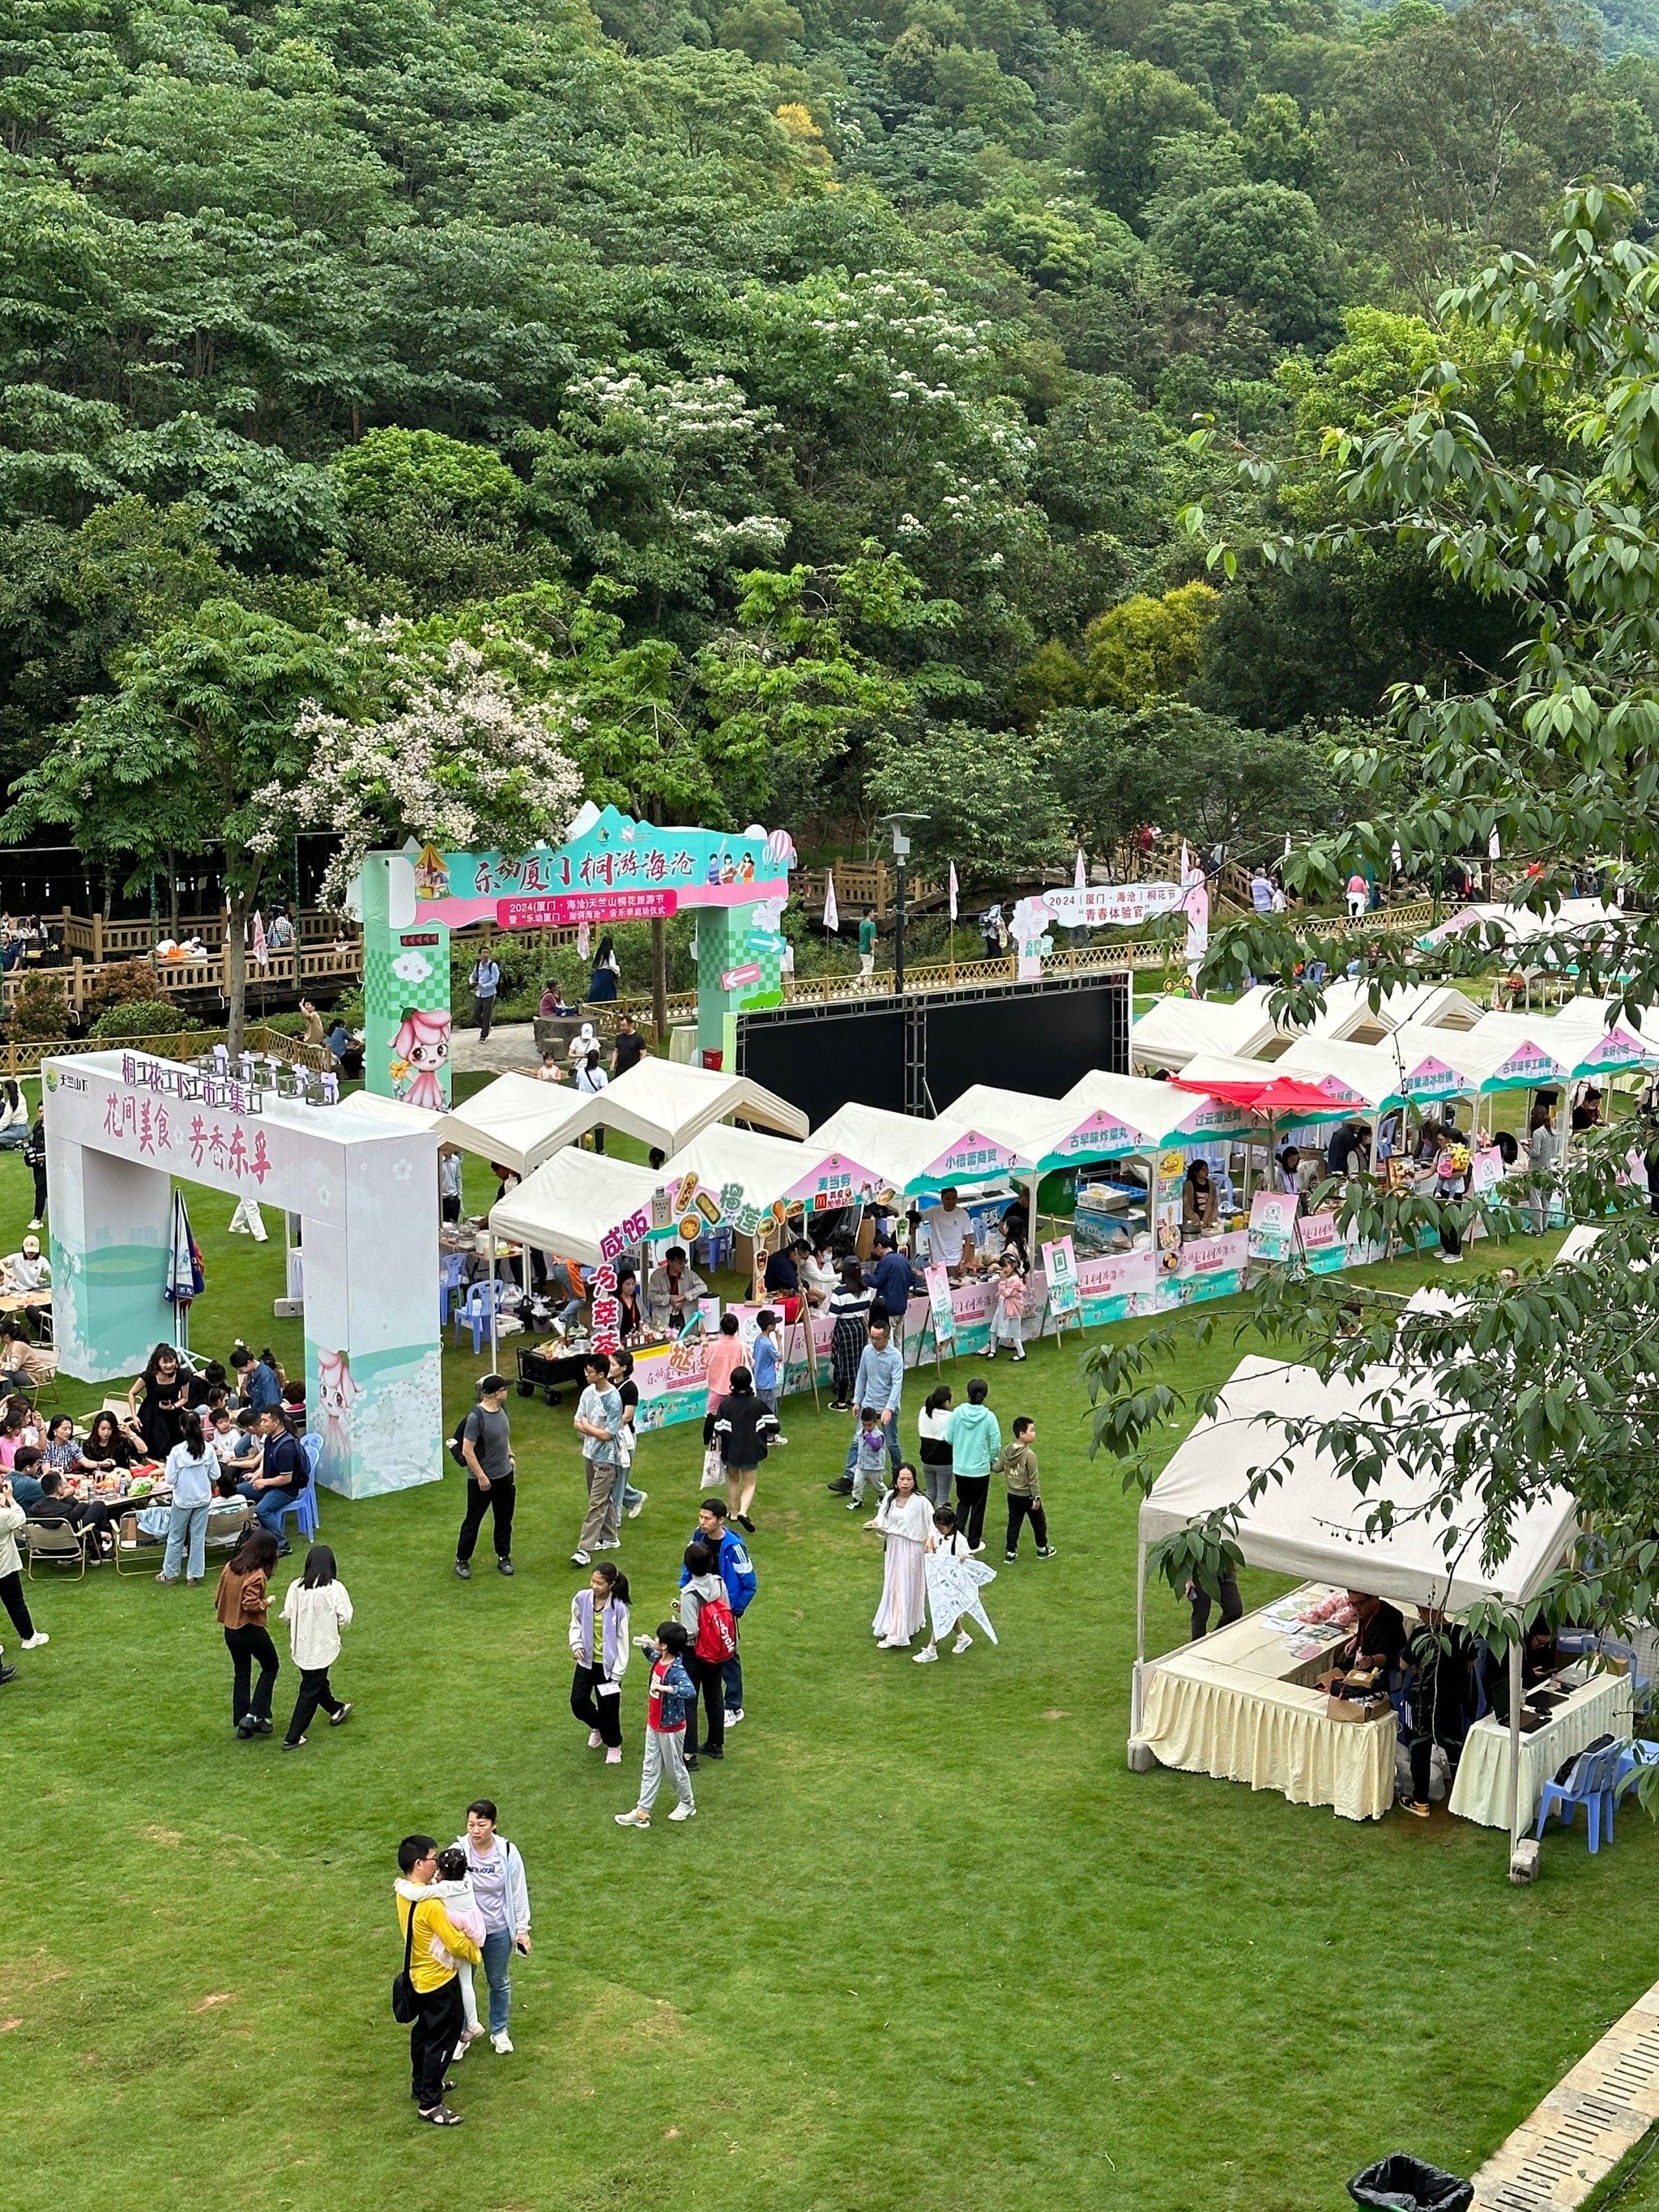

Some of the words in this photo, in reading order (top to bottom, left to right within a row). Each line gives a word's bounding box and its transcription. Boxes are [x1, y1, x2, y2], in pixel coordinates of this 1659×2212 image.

[474, 855, 570, 893] 乐动厦门
[579, 850, 695, 887] 桐游海沧
[1078, 905, 1150, 922] “青春体验官”
[122, 1052, 246, 1116] 桐花下市集
[103, 1092, 173, 1157] 花间美食
[188, 1113, 272, 1186] 芳香东孚
[818, 1173, 851, 1191] 麦当劳
[600, 1208, 650, 1262] 咸饭
[720, 1183, 761, 1236] 榴莲
